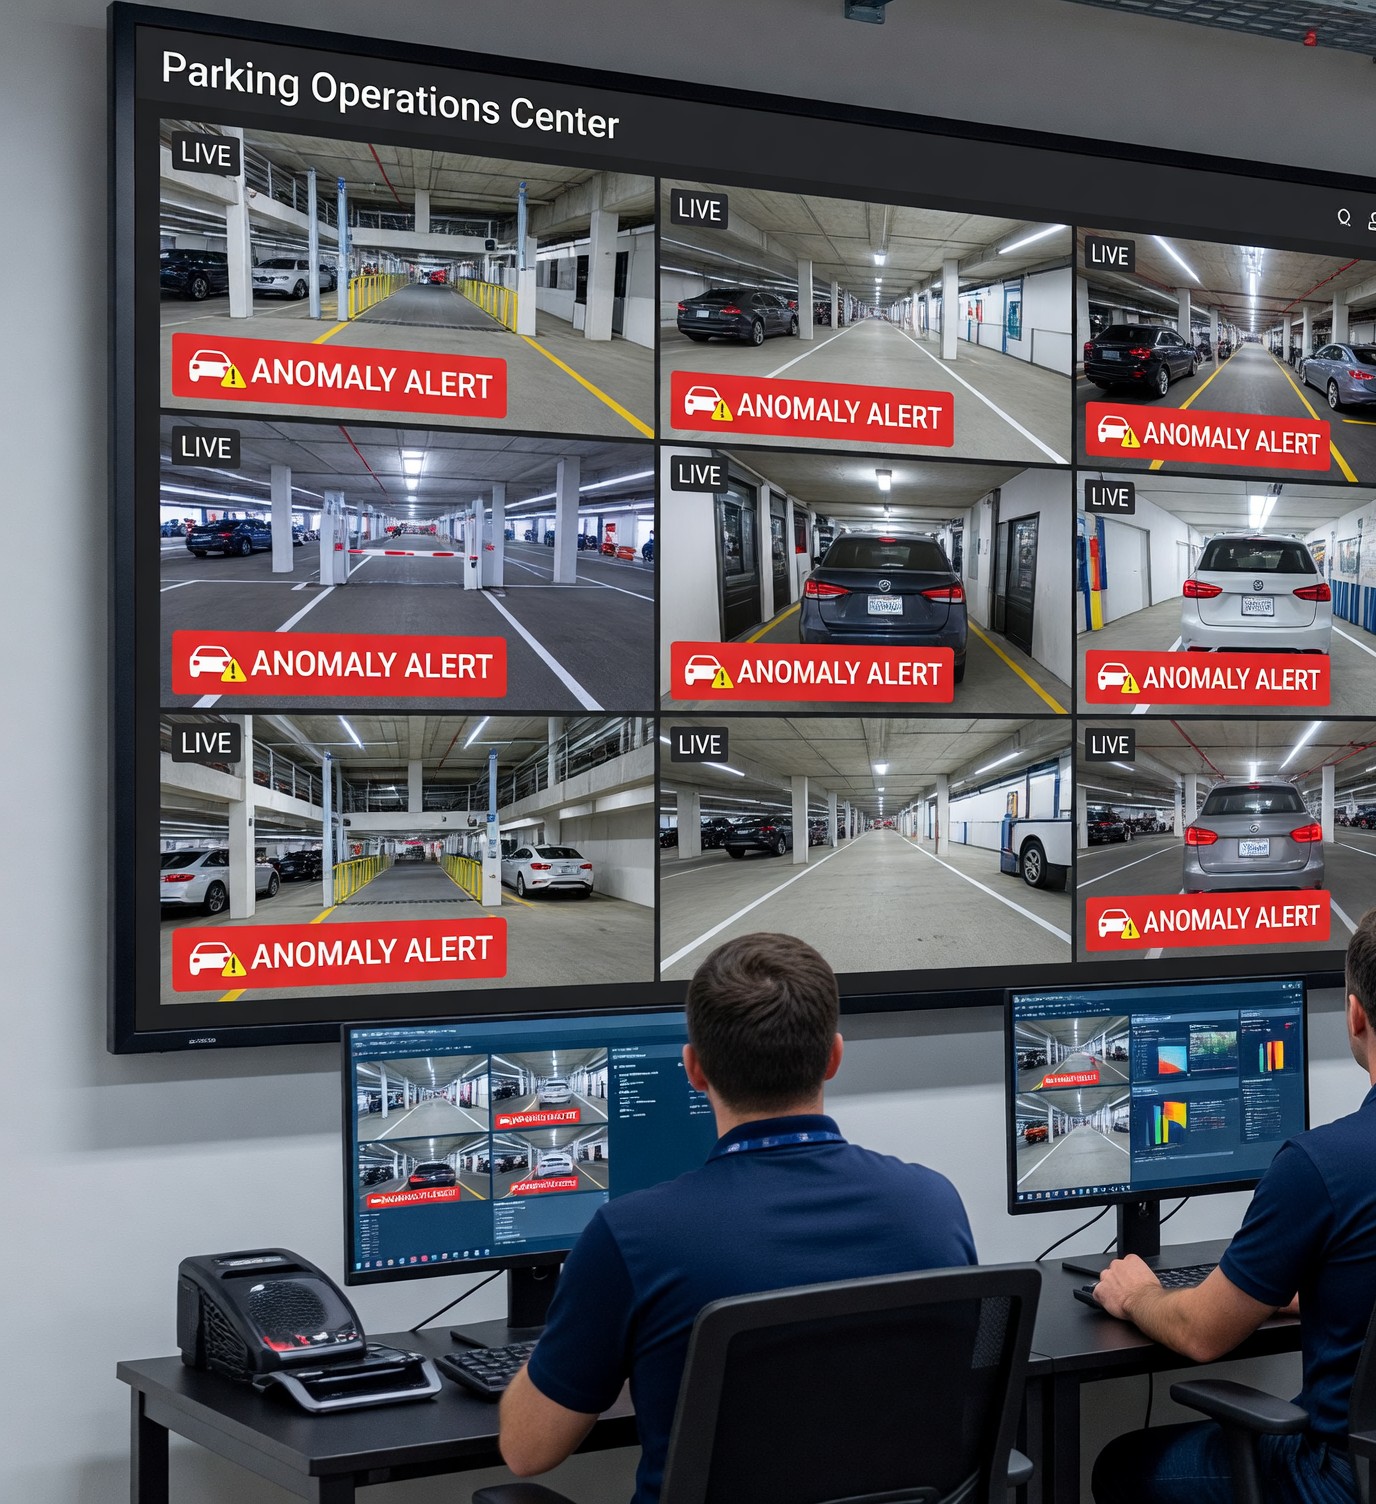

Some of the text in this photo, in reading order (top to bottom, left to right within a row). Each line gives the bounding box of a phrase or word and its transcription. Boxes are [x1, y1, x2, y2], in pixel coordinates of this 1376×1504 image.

[164, 51, 619, 138] Parking Operations Center
[182, 141, 231, 166] LIVE
[680, 198, 721, 221] LIVE
[1093, 244, 1128, 265] LIVE
[251, 358, 493, 398] ANOMALY ALERT
[737, 393, 942, 429] ANOMALY ALERT
[182, 436, 231, 458] LIVE
[1144, 422, 1320, 454] ANOMALY ALERT
[680, 464, 720, 485] LIVE
[1093, 487, 1128, 506] LIVE
[251, 650, 493, 678] ANOMALY ALERT
[737, 660, 942, 685] ANOMALY ALERT
[1143, 667, 1320, 690] ANOMALY ALERT
[183, 732, 231, 753] LIVE
[680, 735, 721, 754] LIVE
[1093, 736, 1128, 753] LIVE
[1144, 905, 1320, 933] ANOMALY ALERT
[251, 936, 493, 969] ANOMALY ALERT
